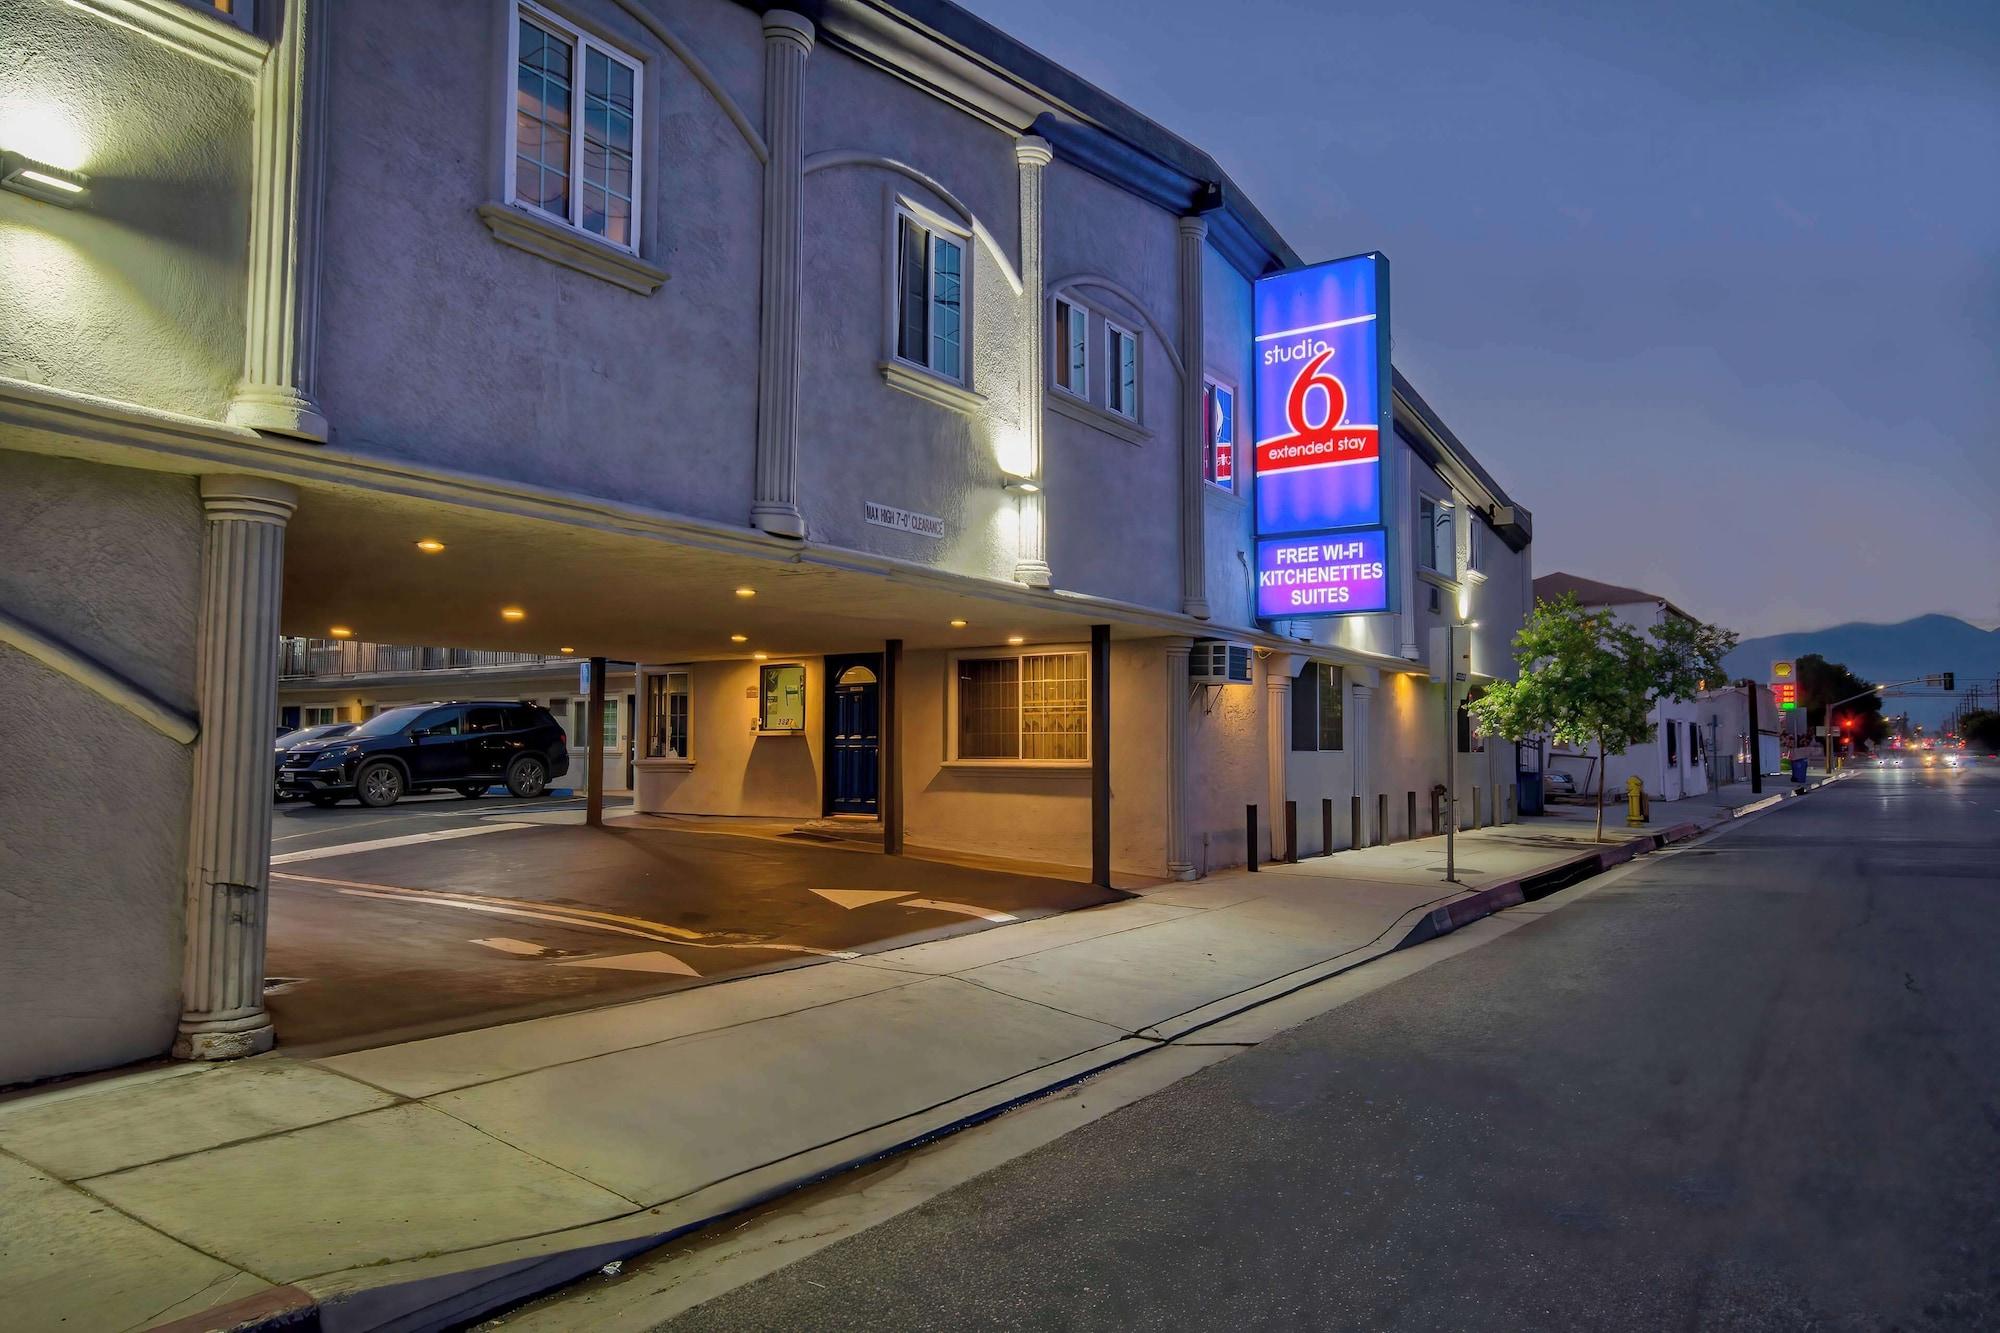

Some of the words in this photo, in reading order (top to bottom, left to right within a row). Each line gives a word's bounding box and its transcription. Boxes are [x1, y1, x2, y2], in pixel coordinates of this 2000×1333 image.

[1264, 339, 1328, 366] studio
[1285, 347, 1348, 436] 6
[1268, 438, 1334, 460] extended
[1337, 436, 1367, 451] stay
[866, 505, 878, 520] MAX
[880, 508, 895, 524] HIGH
[911, 515, 943, 536] CLEARANCE
[1277, 546, 1319, 565] FREE
[1322, 542, 1363, 561] WI-FI
[1259, 562, 1384, 587] KITCHENETTES
[1290, 586, 1350, 606] SUITES
